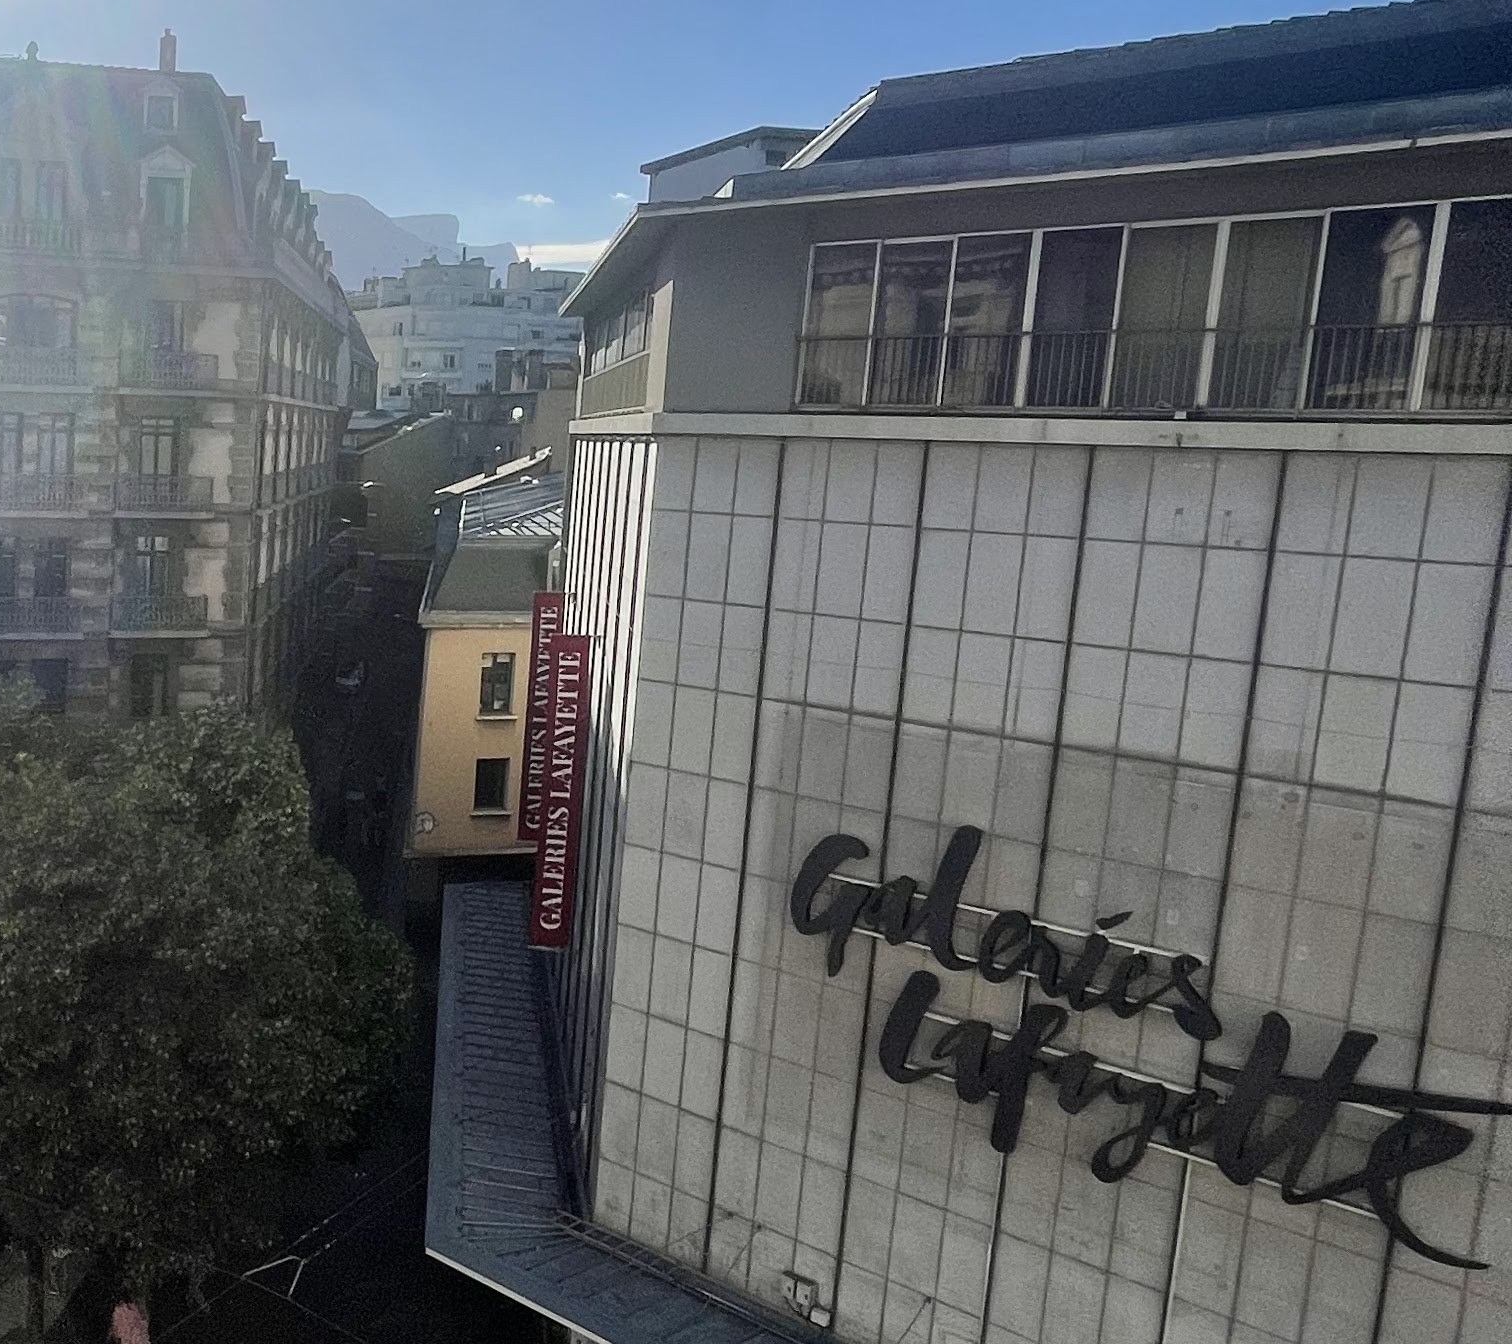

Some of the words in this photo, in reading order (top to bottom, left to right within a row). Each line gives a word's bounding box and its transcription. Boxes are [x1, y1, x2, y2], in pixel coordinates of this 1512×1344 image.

[531, 606, 559, 724] LAFAYETTE
[549, 651, 582, 800] LAFAYETTE
[524, 729, 548, 830] GALERIES
[539, 806, 570, 931] GALERIES
[790, 824, 1223, 1041] Galeries
[879, 971, 1512, 1271] Lafayette
